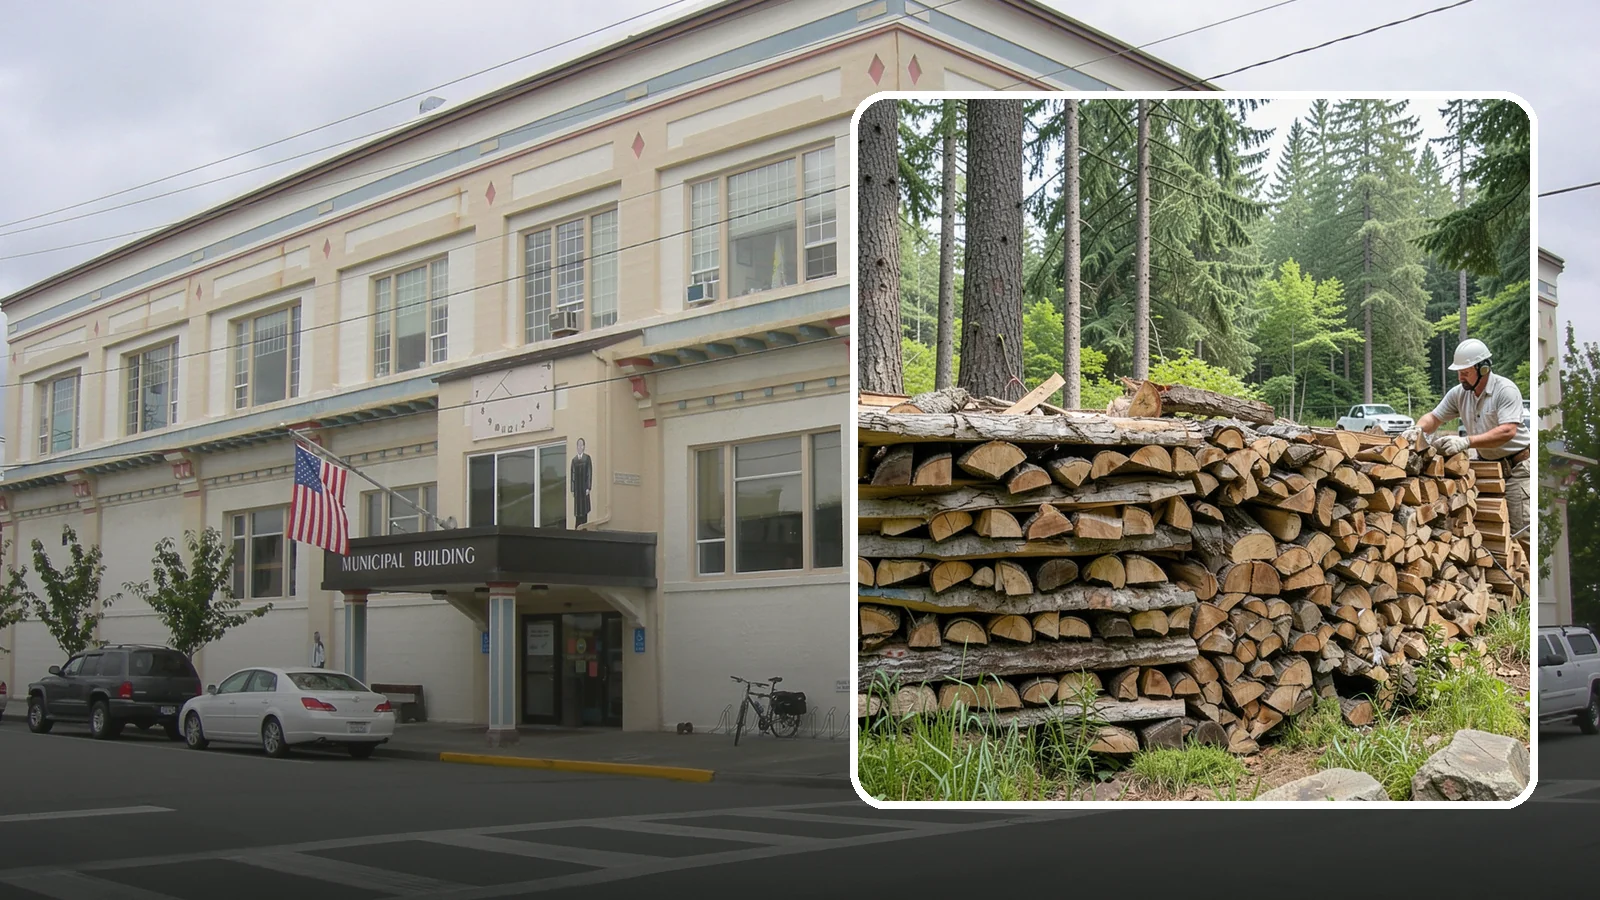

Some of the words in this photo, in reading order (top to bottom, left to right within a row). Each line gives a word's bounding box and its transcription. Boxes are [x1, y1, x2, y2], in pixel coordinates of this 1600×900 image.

[475, 390, 479, 398] 7
[536, 402, 540, 410] 4
[480, 407, 485, 415] 8
[487, 417, 492, 426] 9
[528, 414, 533, 422] 3
[521, 420, 526, 428] 2
[507, 425, 513, 433] 12
[342, 552, 405, 572] MUNICIPAL
[414, 546, 476, 567] BUILDING
